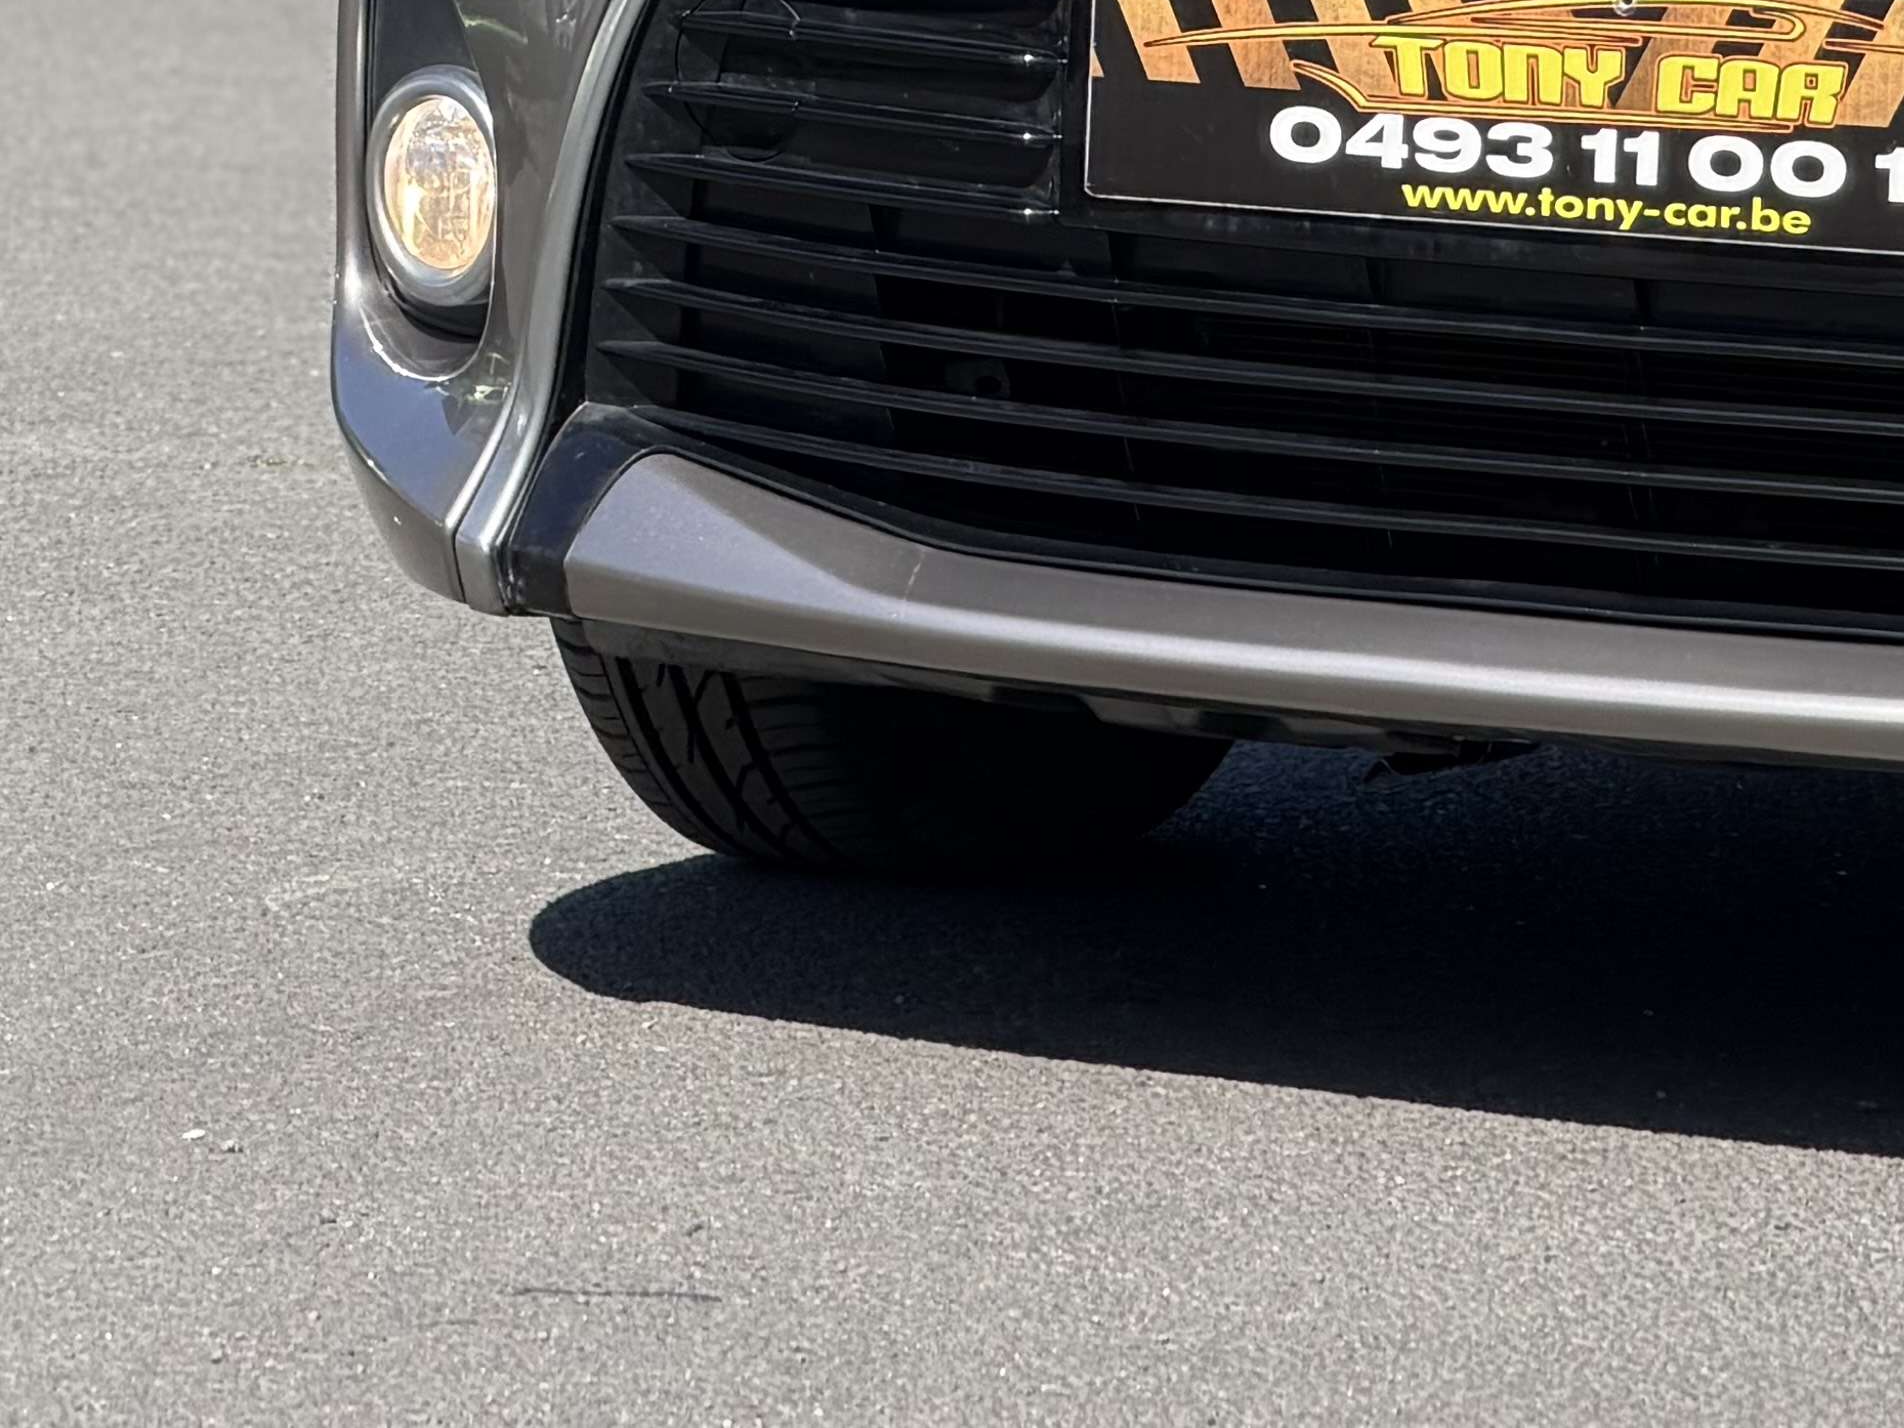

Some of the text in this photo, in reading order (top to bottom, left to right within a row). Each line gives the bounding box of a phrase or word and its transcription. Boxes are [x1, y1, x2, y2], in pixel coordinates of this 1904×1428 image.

[1371, 33, 1846, 124] TONY CAR
[1268, 104, 1555, 179] 0493
[1580, 127, 1661, 187] 11
[1687, 134, 1848, 198] 00
[1401, 183, 1812, 235] www.tony-car.be
